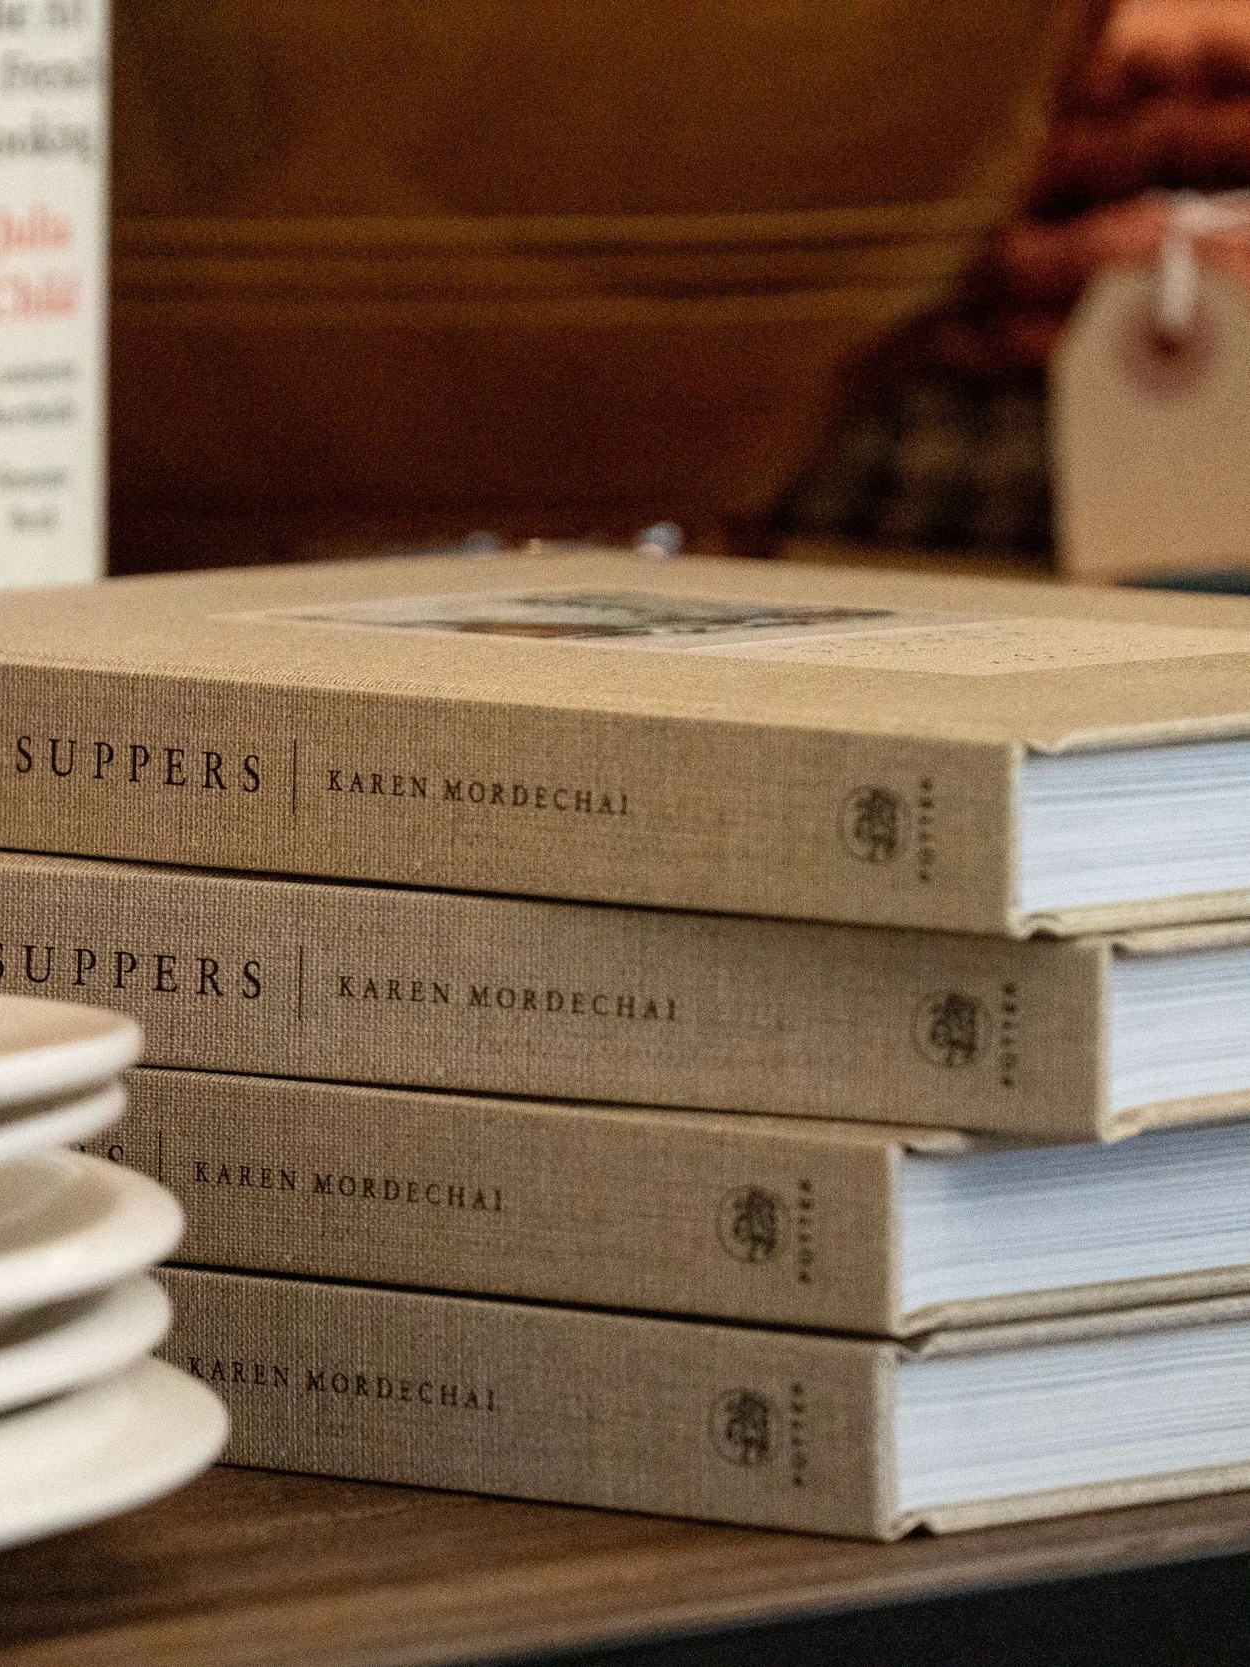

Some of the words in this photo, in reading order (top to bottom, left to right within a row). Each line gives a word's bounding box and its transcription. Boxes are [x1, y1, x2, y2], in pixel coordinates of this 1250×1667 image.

[14, 735, 262, 794] SUPPERS
[327, 769, 429, 800] KAREN
[442, 780, 631, 817] MORDECHAI
[338, 975, 452, 1005] KAREN
[468, 985, 679, 1022] MORDECHAI
[193, 1161, 298, 1193] KAREN
[313, 1172, 506, 1212] MORDECHAI
[187, 1356, 290, 1388] KAREN
[305, 1367, 497, 1413] MORDECHAI
